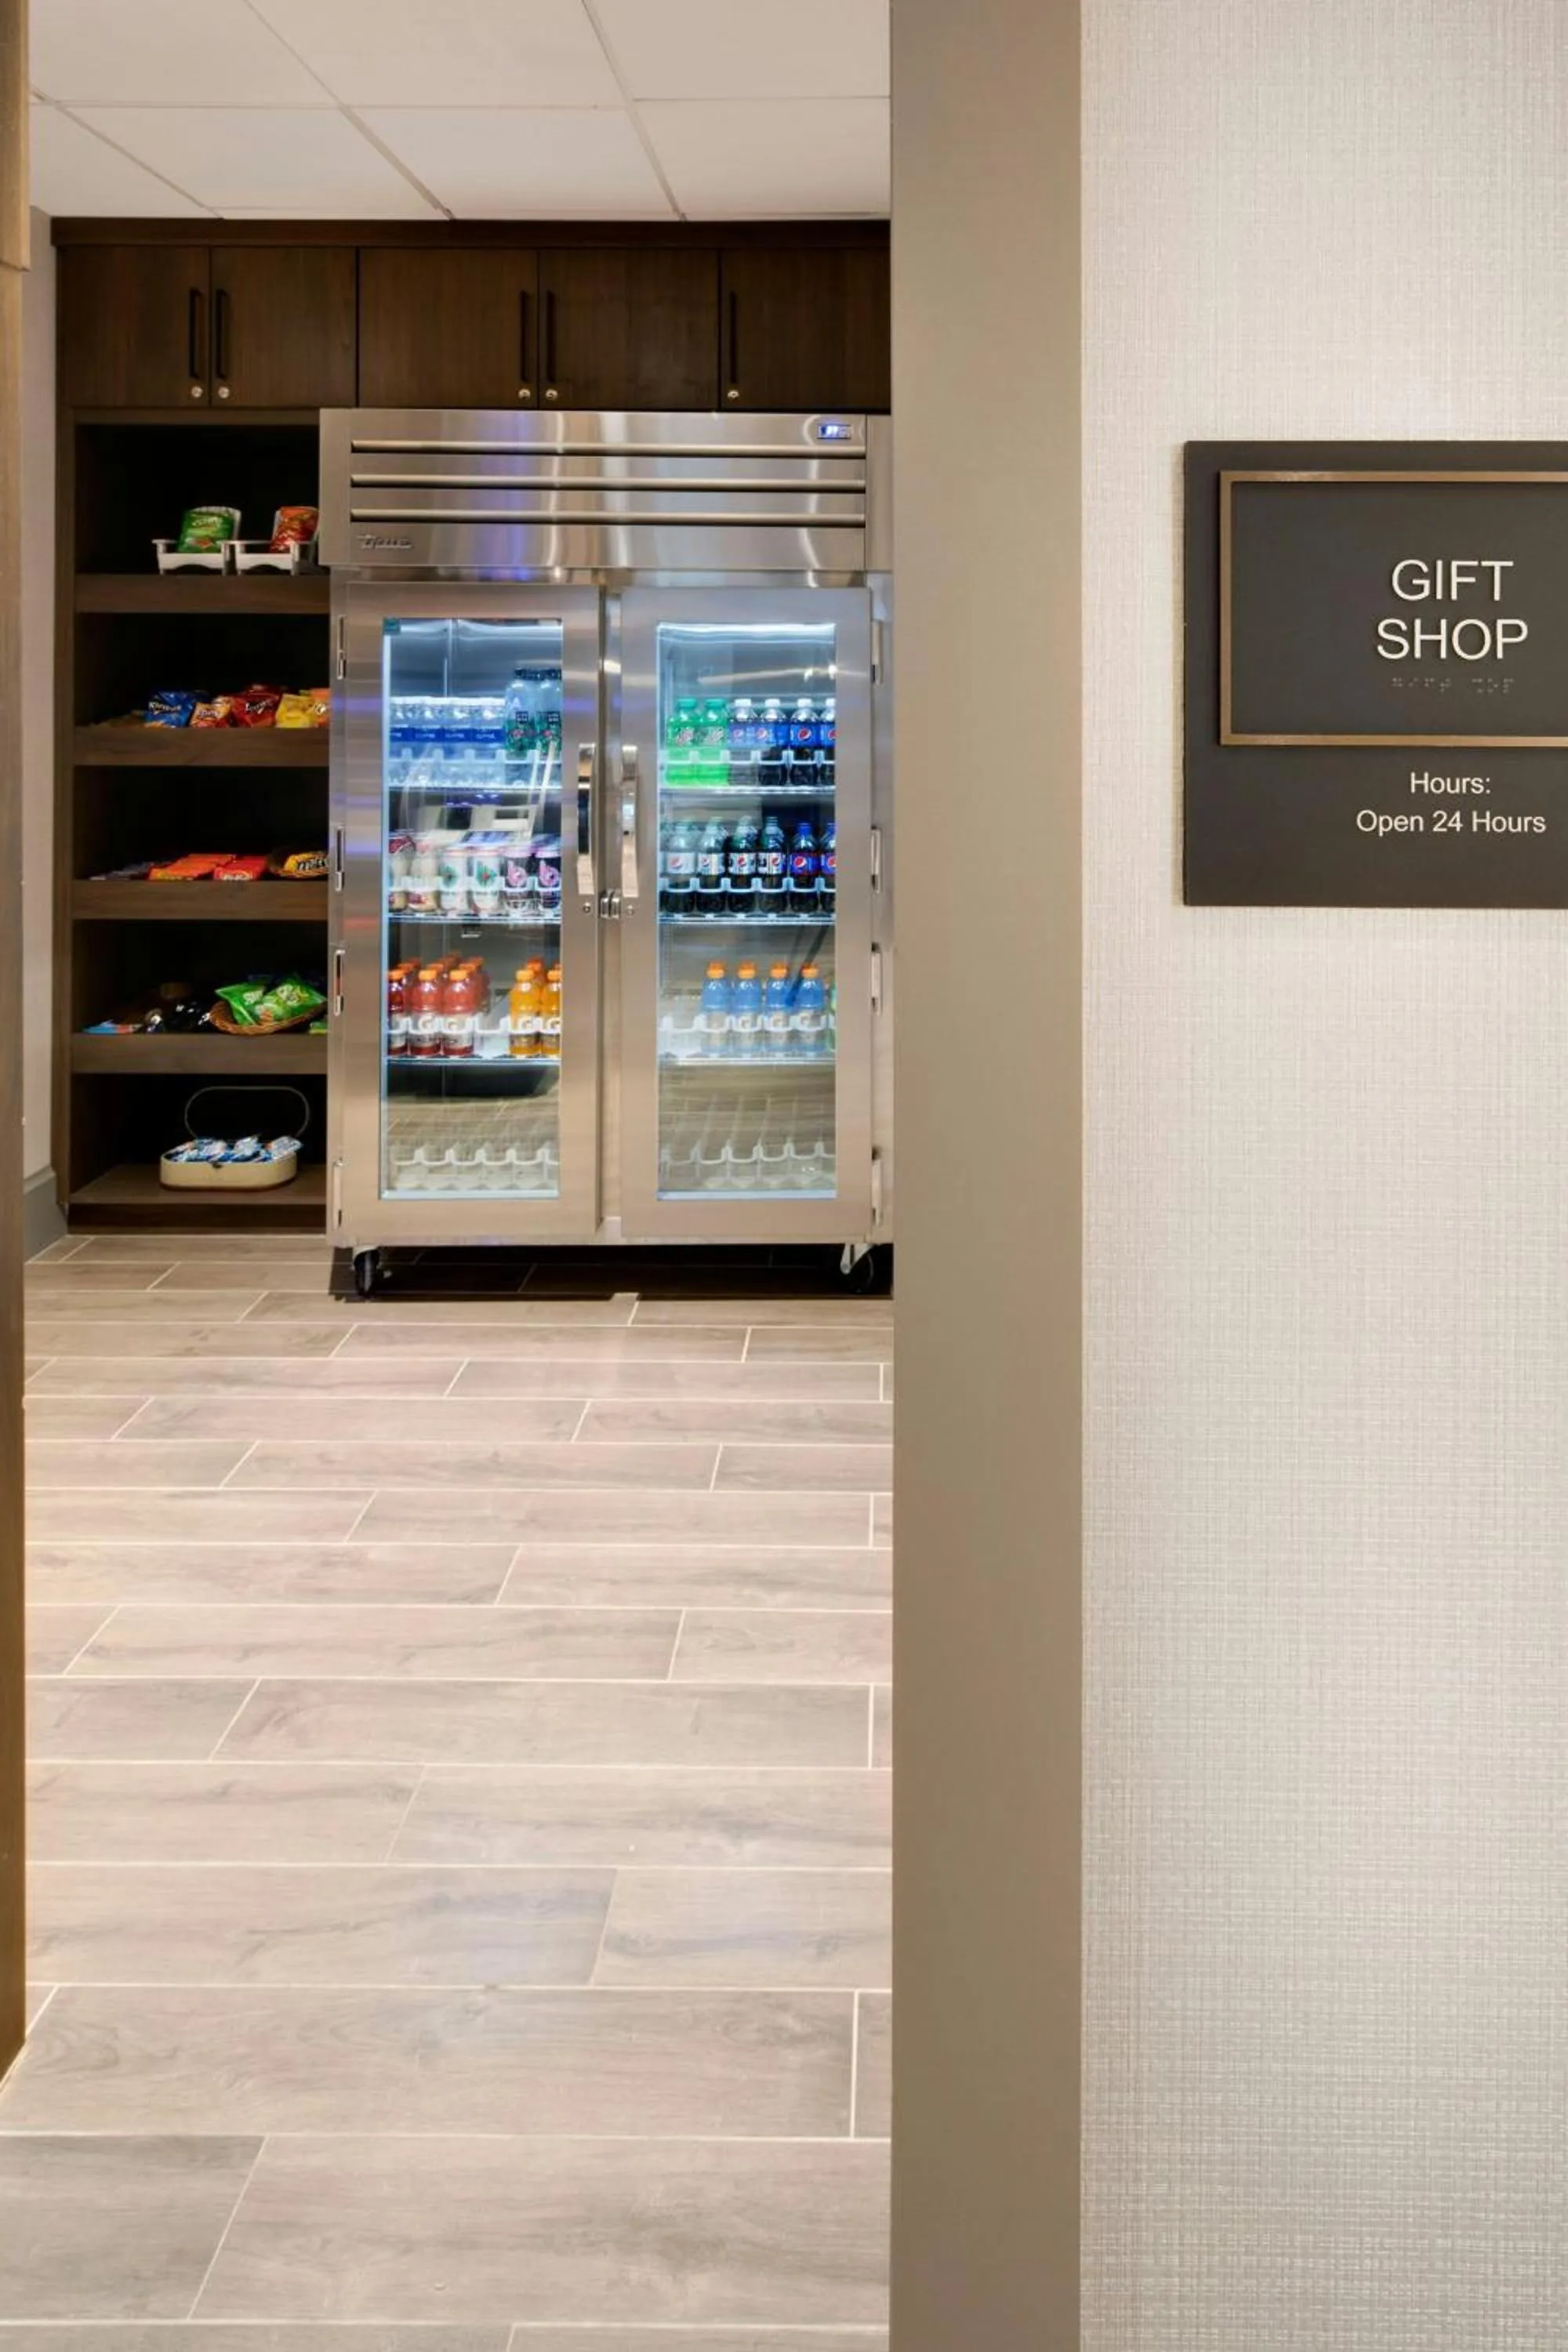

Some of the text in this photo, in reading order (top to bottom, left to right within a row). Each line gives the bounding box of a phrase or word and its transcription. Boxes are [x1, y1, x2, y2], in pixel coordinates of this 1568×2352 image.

[1392, 559, 1514, 601] GIFT
[1377, 618, 1528, 660] SHOP
[1410, 771, 1490, 794] Hours:
[1356, 810, 1547, 837] Open 24 Hours
